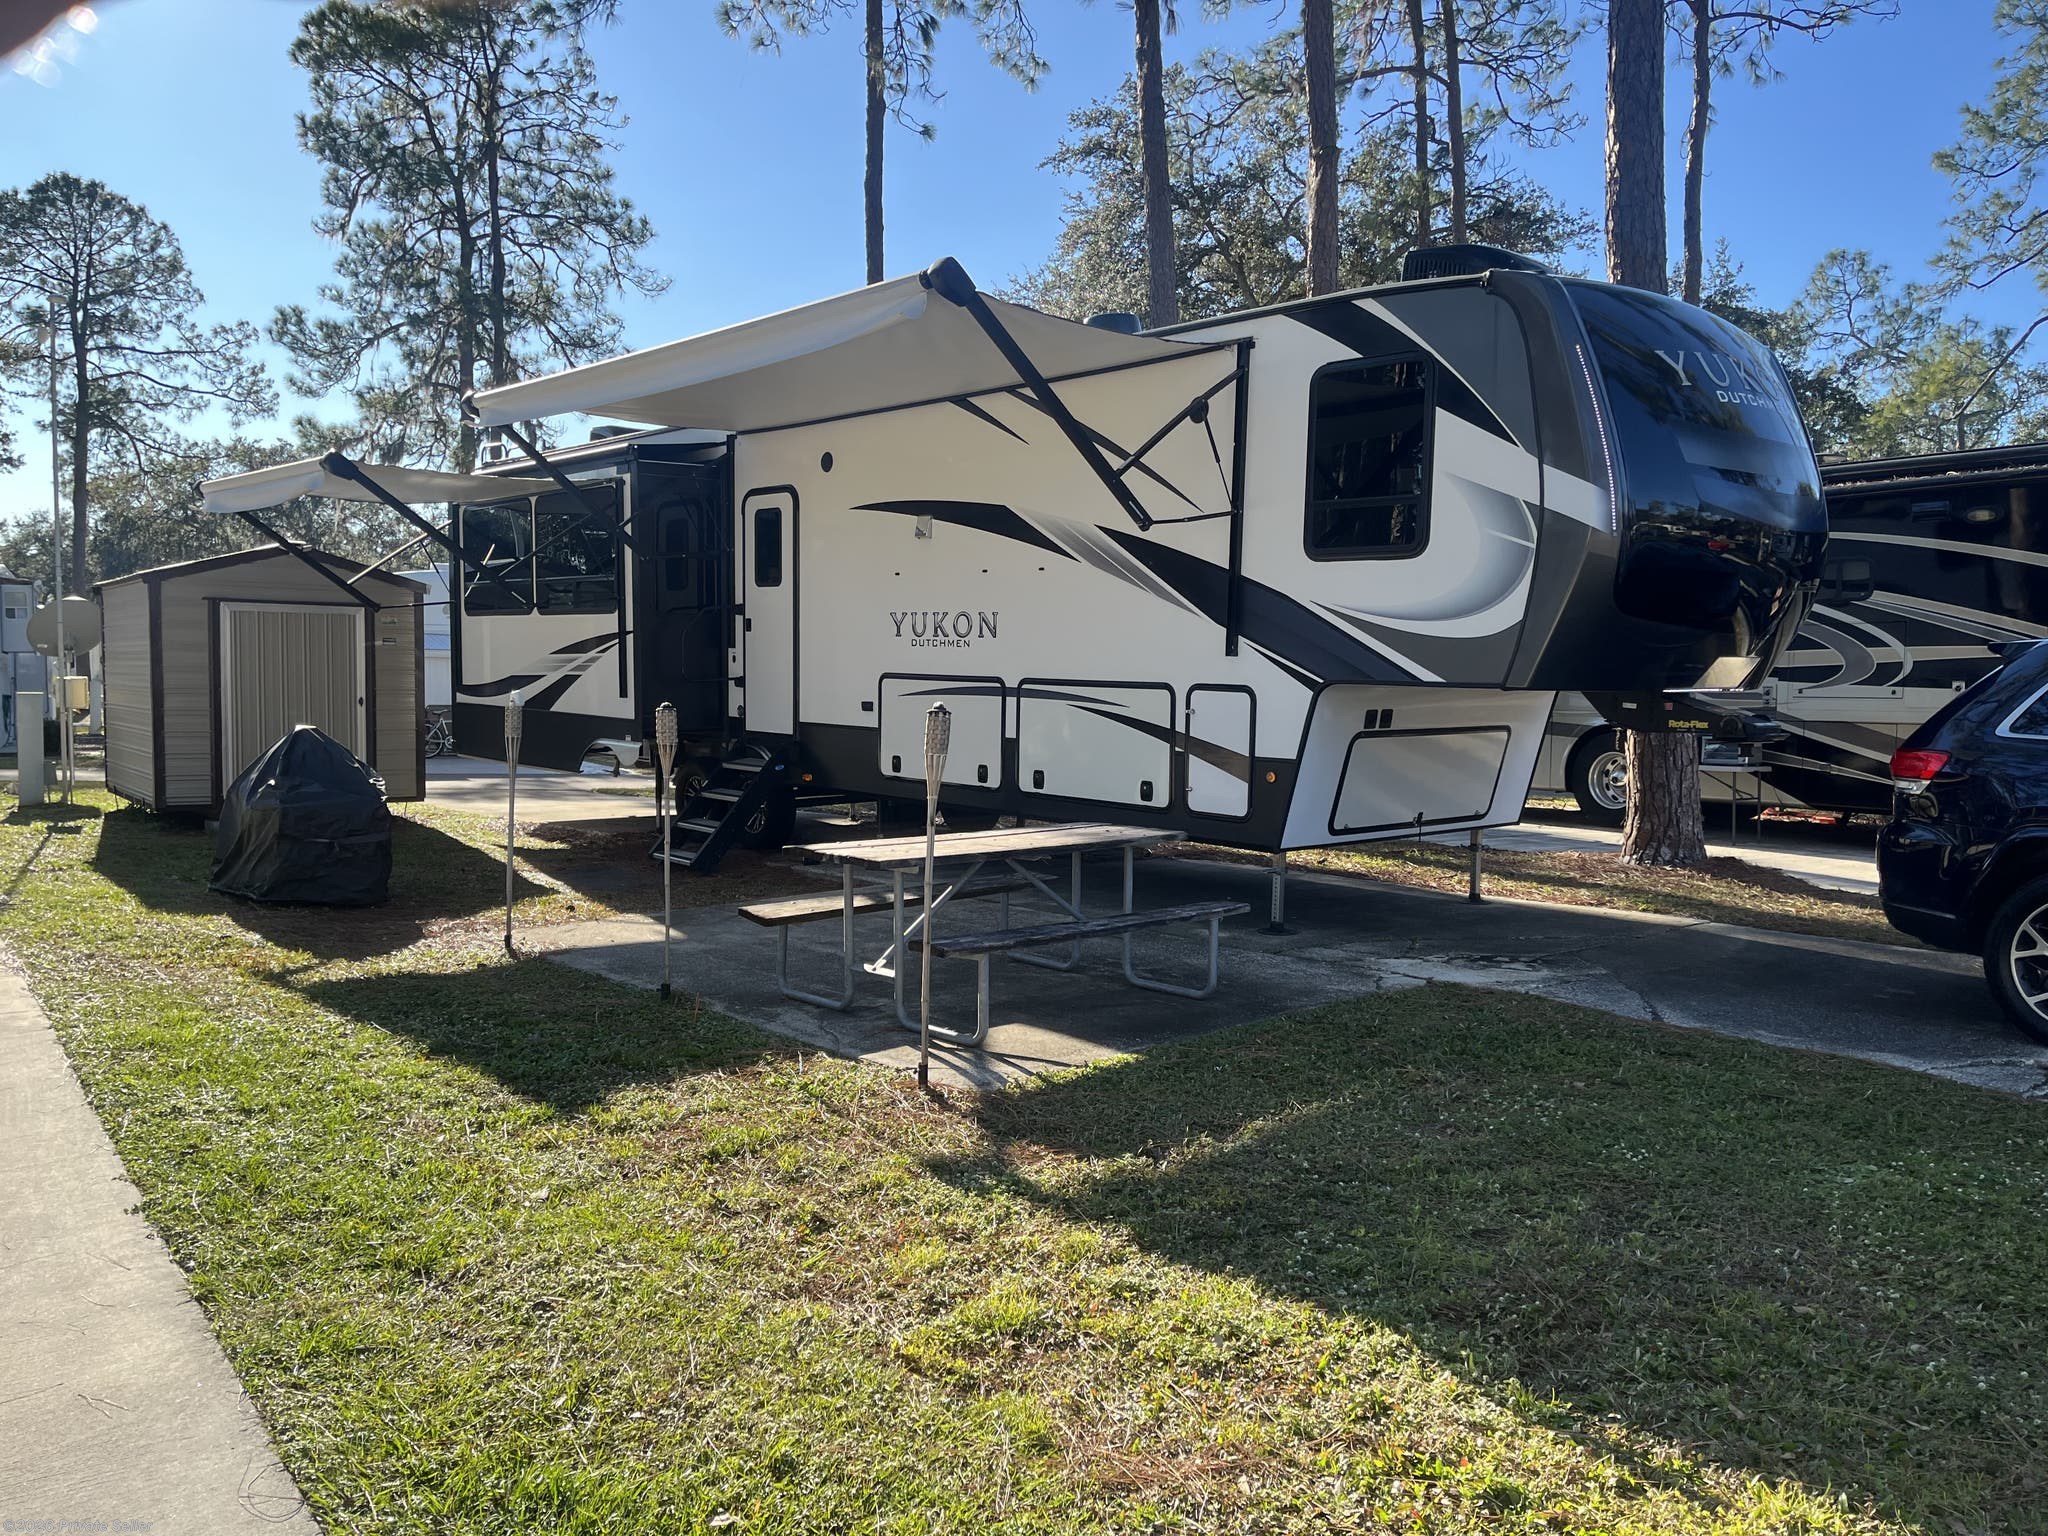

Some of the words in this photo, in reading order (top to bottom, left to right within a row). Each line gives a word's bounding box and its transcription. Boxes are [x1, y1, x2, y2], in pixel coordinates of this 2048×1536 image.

[889, 611, 999, 638] YUKON
[911, 638, 971, 648] DUTCHMEN
[1668, 719, 1709, 729] Rota-Flex
